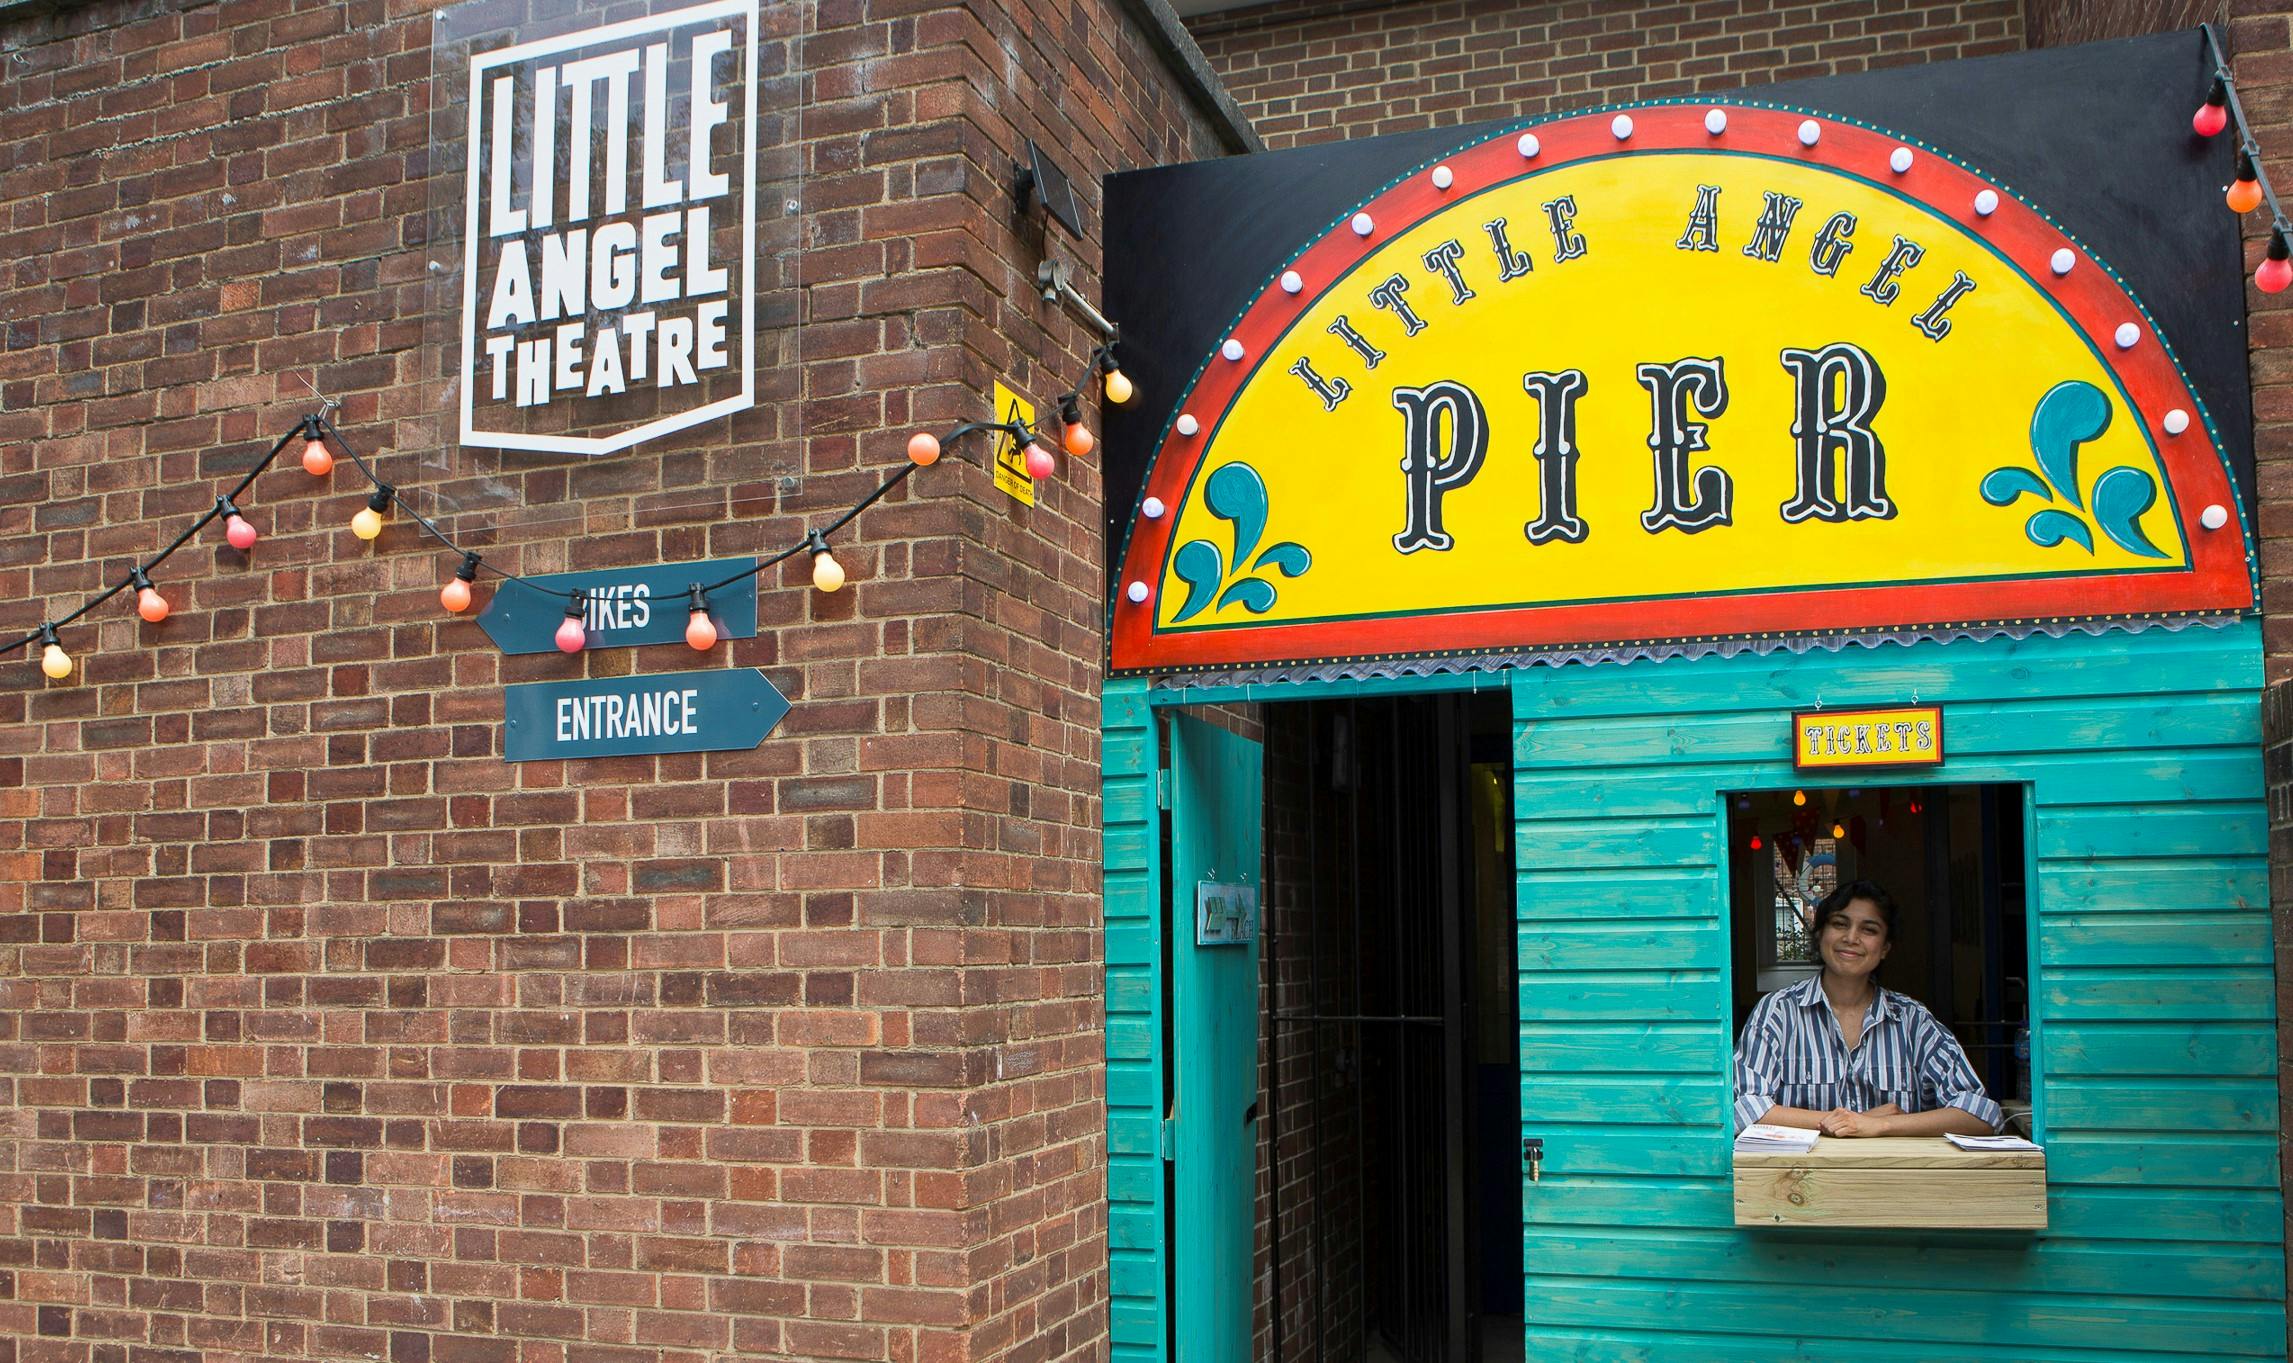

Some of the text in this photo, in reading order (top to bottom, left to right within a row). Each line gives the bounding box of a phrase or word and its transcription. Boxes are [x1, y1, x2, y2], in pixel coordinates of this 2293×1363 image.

[489, 29, 732, 237] LITTLE
[486, 207, 729, 329] ANGEL
[1288, 183, 1977, 412] LITTLE ANGEL
[486, 299, 728, 407] THEATRE
[996, 470, 1014, 488] DANGER
[1020, 485, 1033, 496] DEATH
[1391, 341, 1899, 556] PIER
[556, 689, 698, 741] ENTRANCE
[1805, 720, 1931, 755] TICKETS
